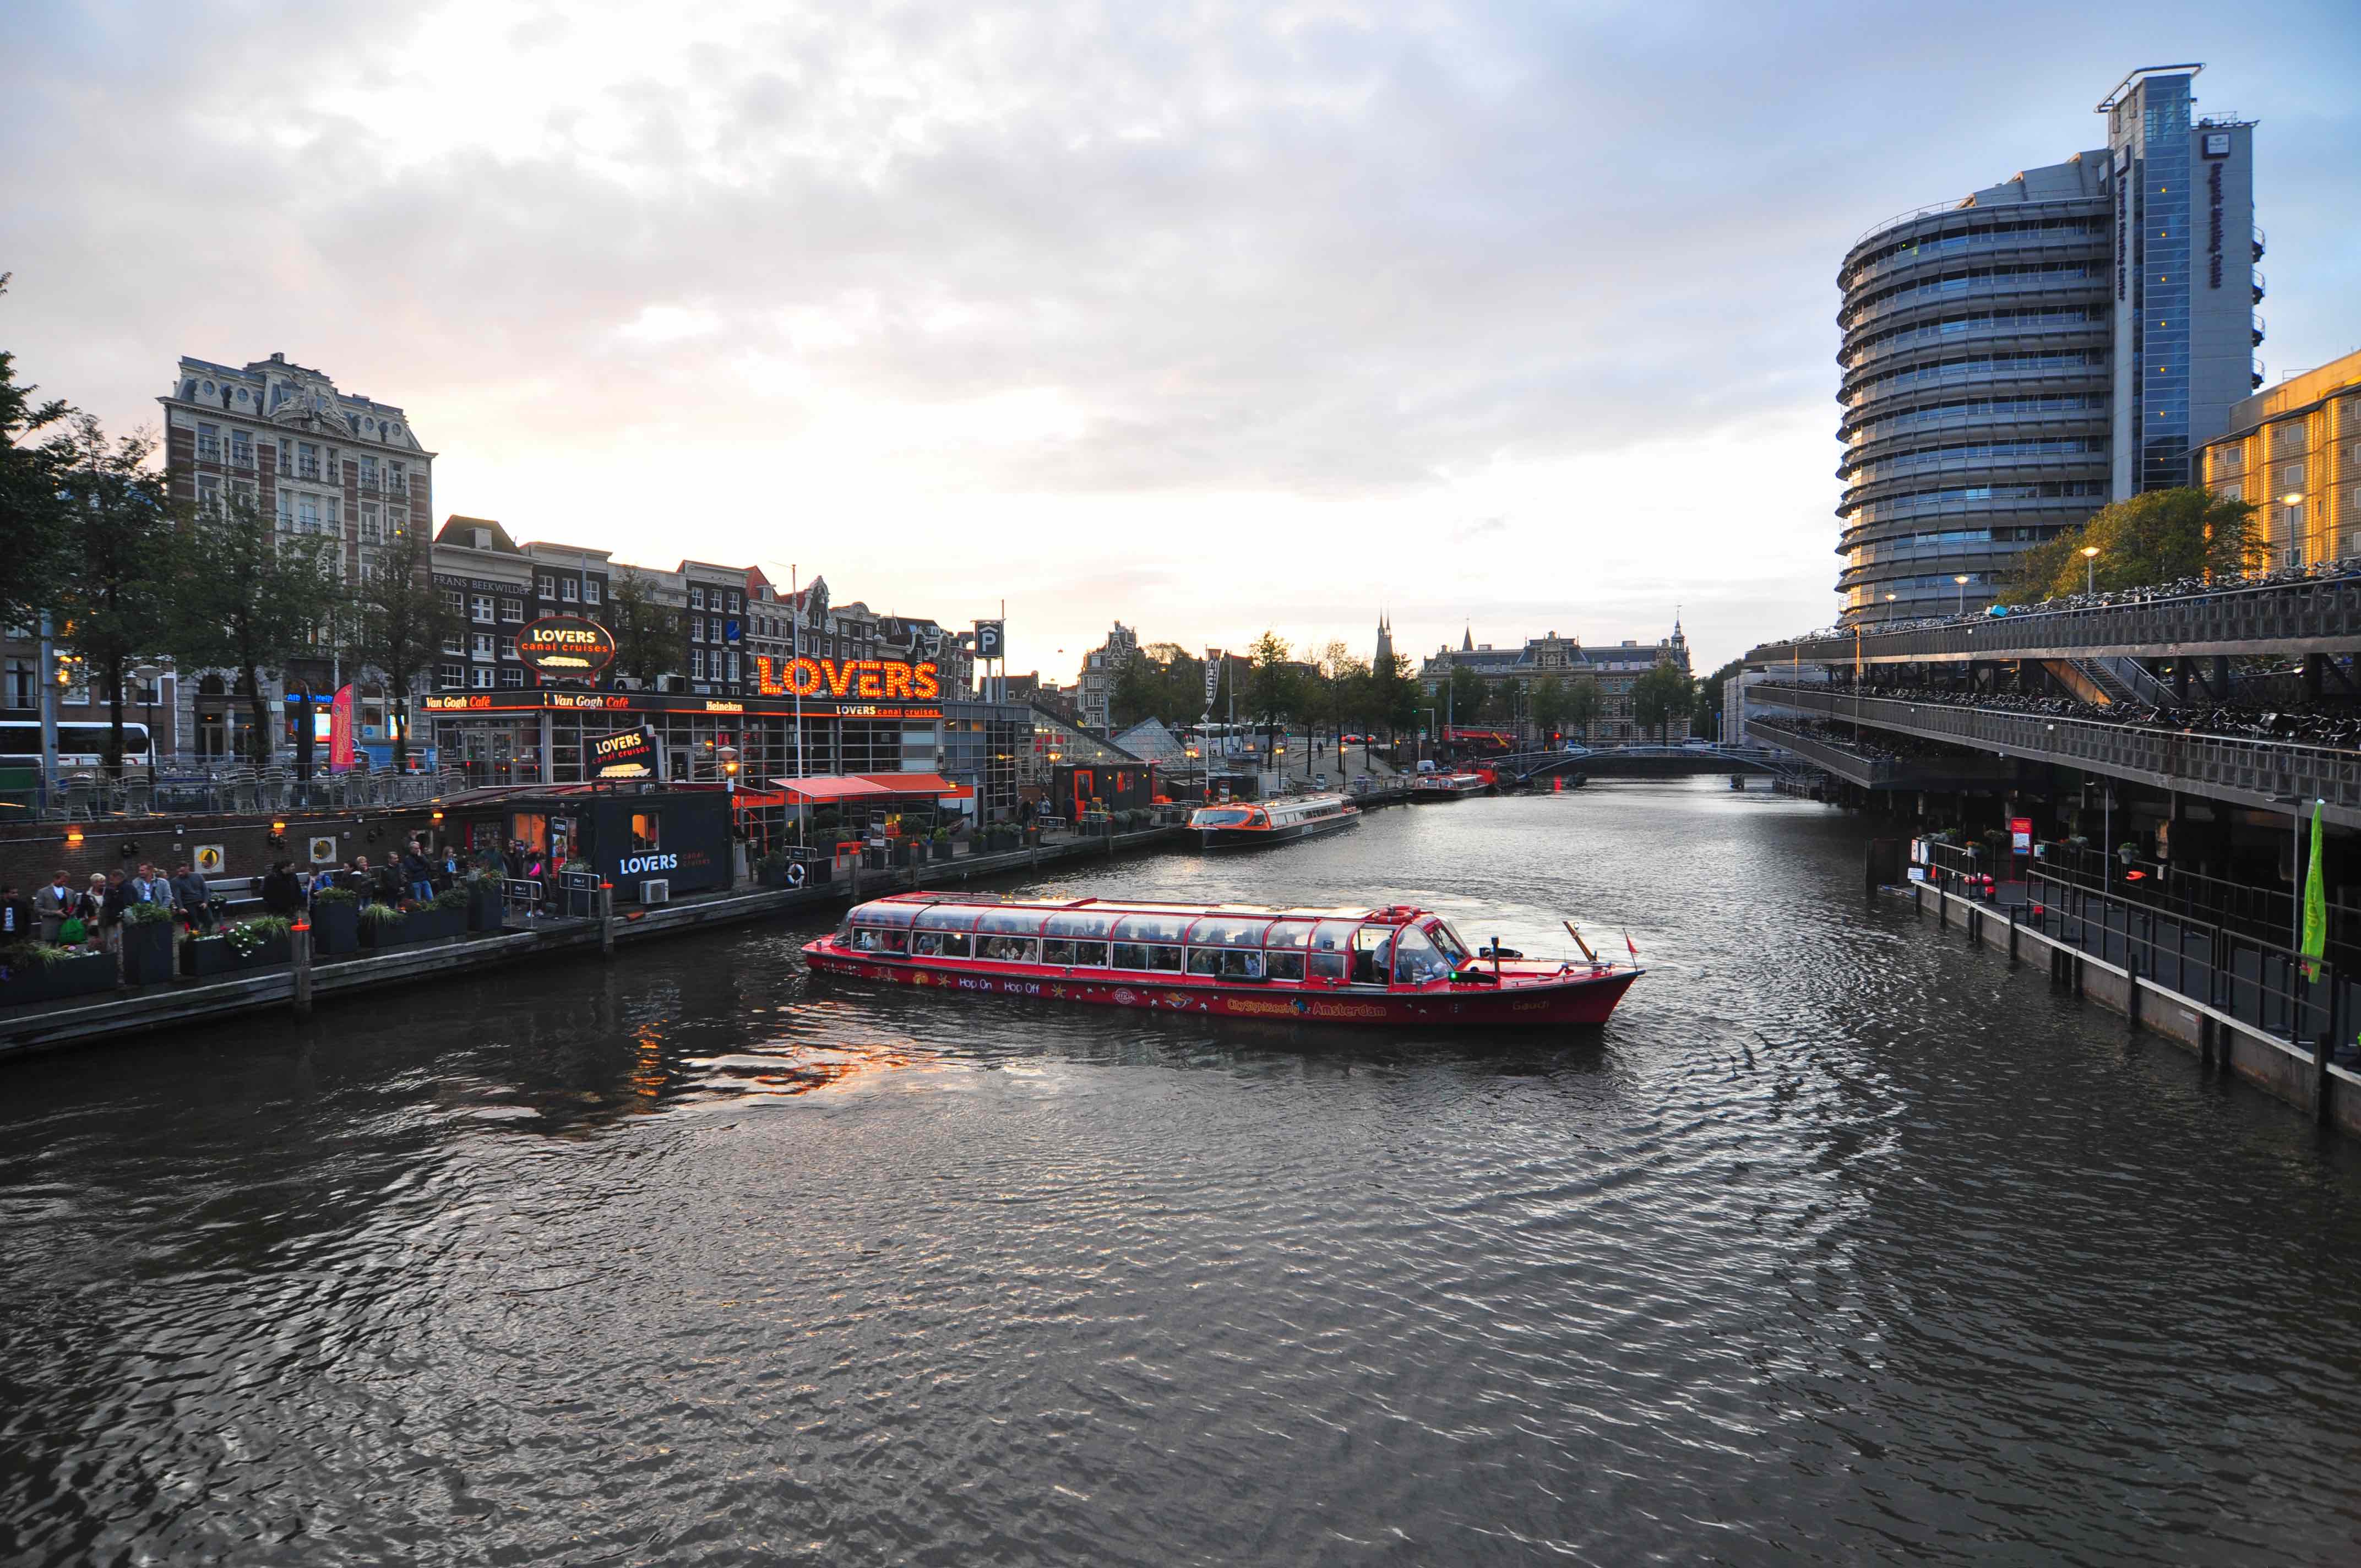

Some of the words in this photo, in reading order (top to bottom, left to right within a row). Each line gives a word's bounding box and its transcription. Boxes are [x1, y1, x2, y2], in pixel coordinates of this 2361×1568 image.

[433, 574, 467, 587] FRANS
[533, 629, 596, 644] LOVERS
[982, 633, 996, 652] P
[522, 643, 556, 651] canal
[562, 644, 608, 652] cruises
[757, 656, 938, 699] LOVERS
[1206, 660, 1214, 704] CRUISE
[287, 694, 312, 702] Albt
[426, 696, 442, 708] Van
[444, 696, 467, 709] Gogh
[470, 695, 491, 707] Café
[554, 694, 573, 706] Van
[576, 695, 603, 710] Gogh
[606, 696, 629, 708] Café
[706, 701, 743, 711] Heineken
[836, 705, 876, 715] LOVERS
[596, 733, 641, 755] LOVERS
[591, 752, 614, 765] canal
[618, 745, 650, 758] cruises
[620, 853, 678, 874] LOVERS
[959, 977, 977, 989] Hop
[980, 979, 992, 990] On
[1004, 982, 1022, 993] Hop
[1025, 983, 1040, 994] Off
[1114, 993, 1137, 1001] OFFICIAL
[1313, 1001, 1387, 1016] Amsterdam
